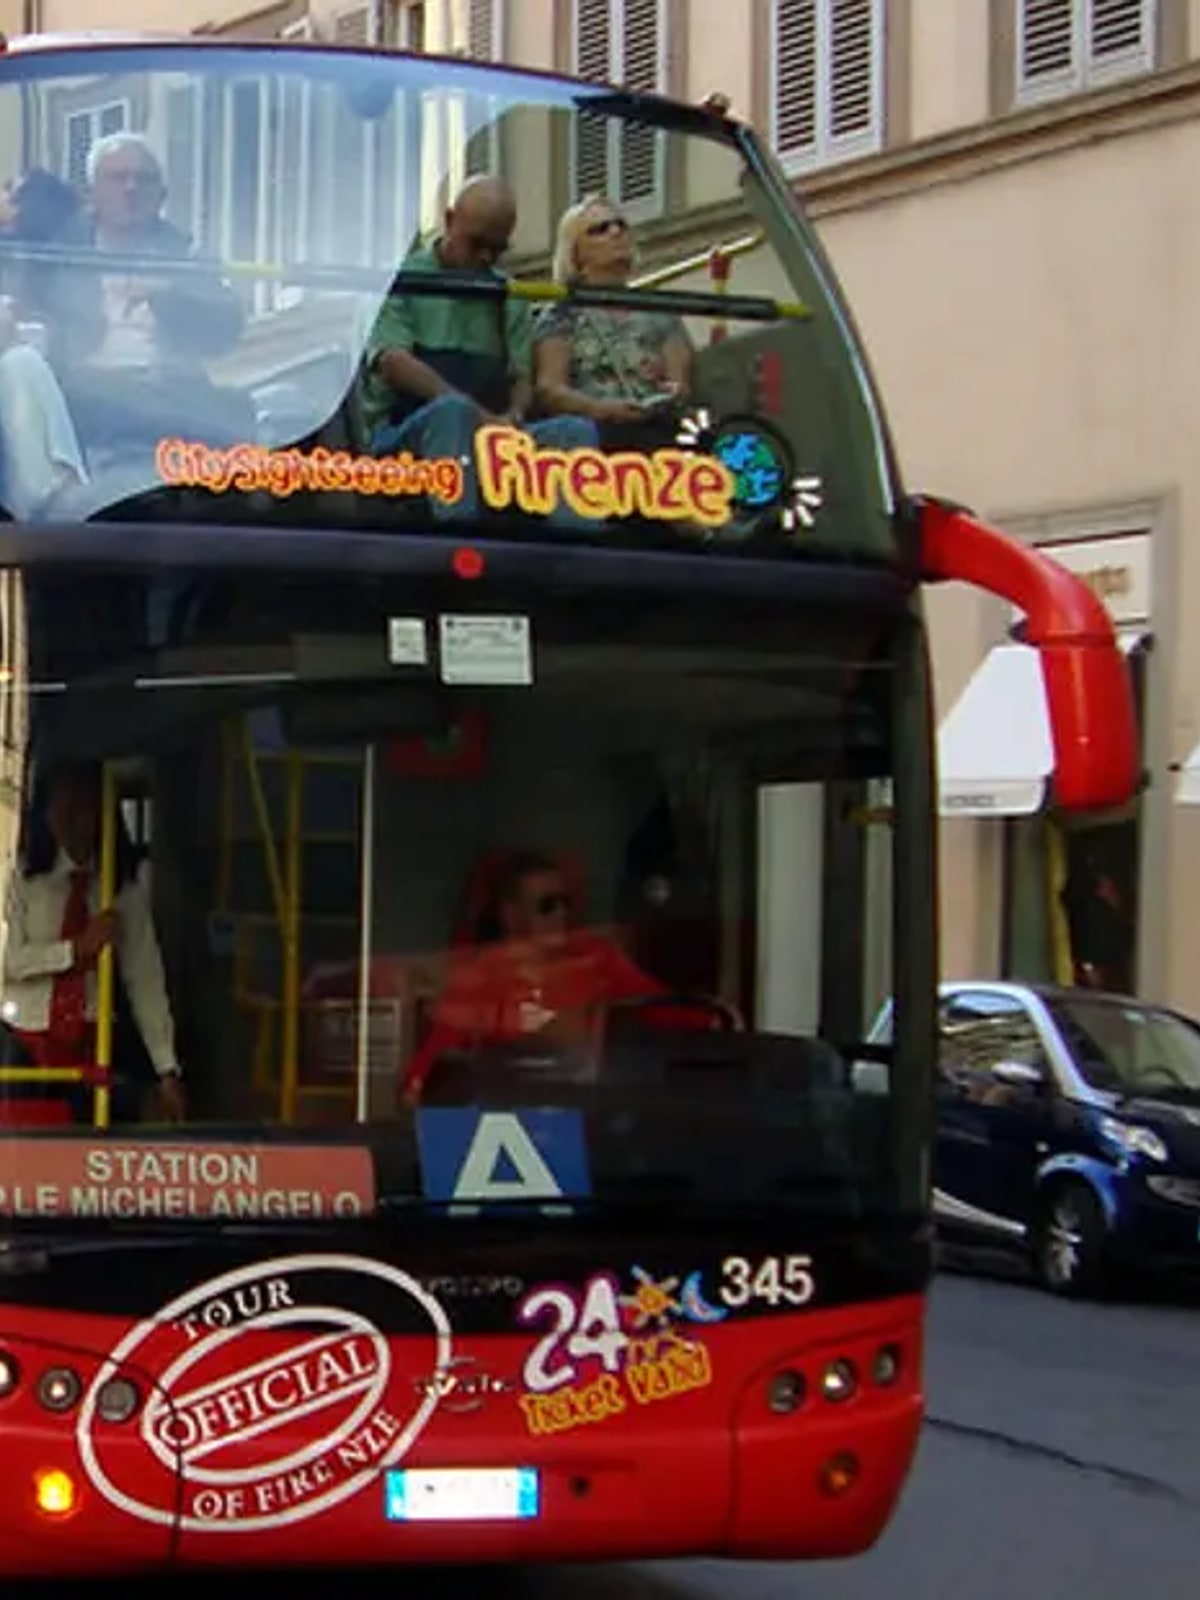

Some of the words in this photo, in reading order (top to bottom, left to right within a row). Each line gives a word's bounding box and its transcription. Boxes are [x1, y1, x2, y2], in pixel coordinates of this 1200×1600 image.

[475, 425, 734, 526] Firenze
[86, 1150, 258, 1186] STATION
[447, 1112, 573, 1215] A
[173, 1279, 295, 1341] TOUR
[720, 1256, 814, 1306] 345
[521, 1277, 629, 1393] 24
[159, 1338, 377, 1448] OFFICIAL
[193, 1489, 245, 1520] OF
